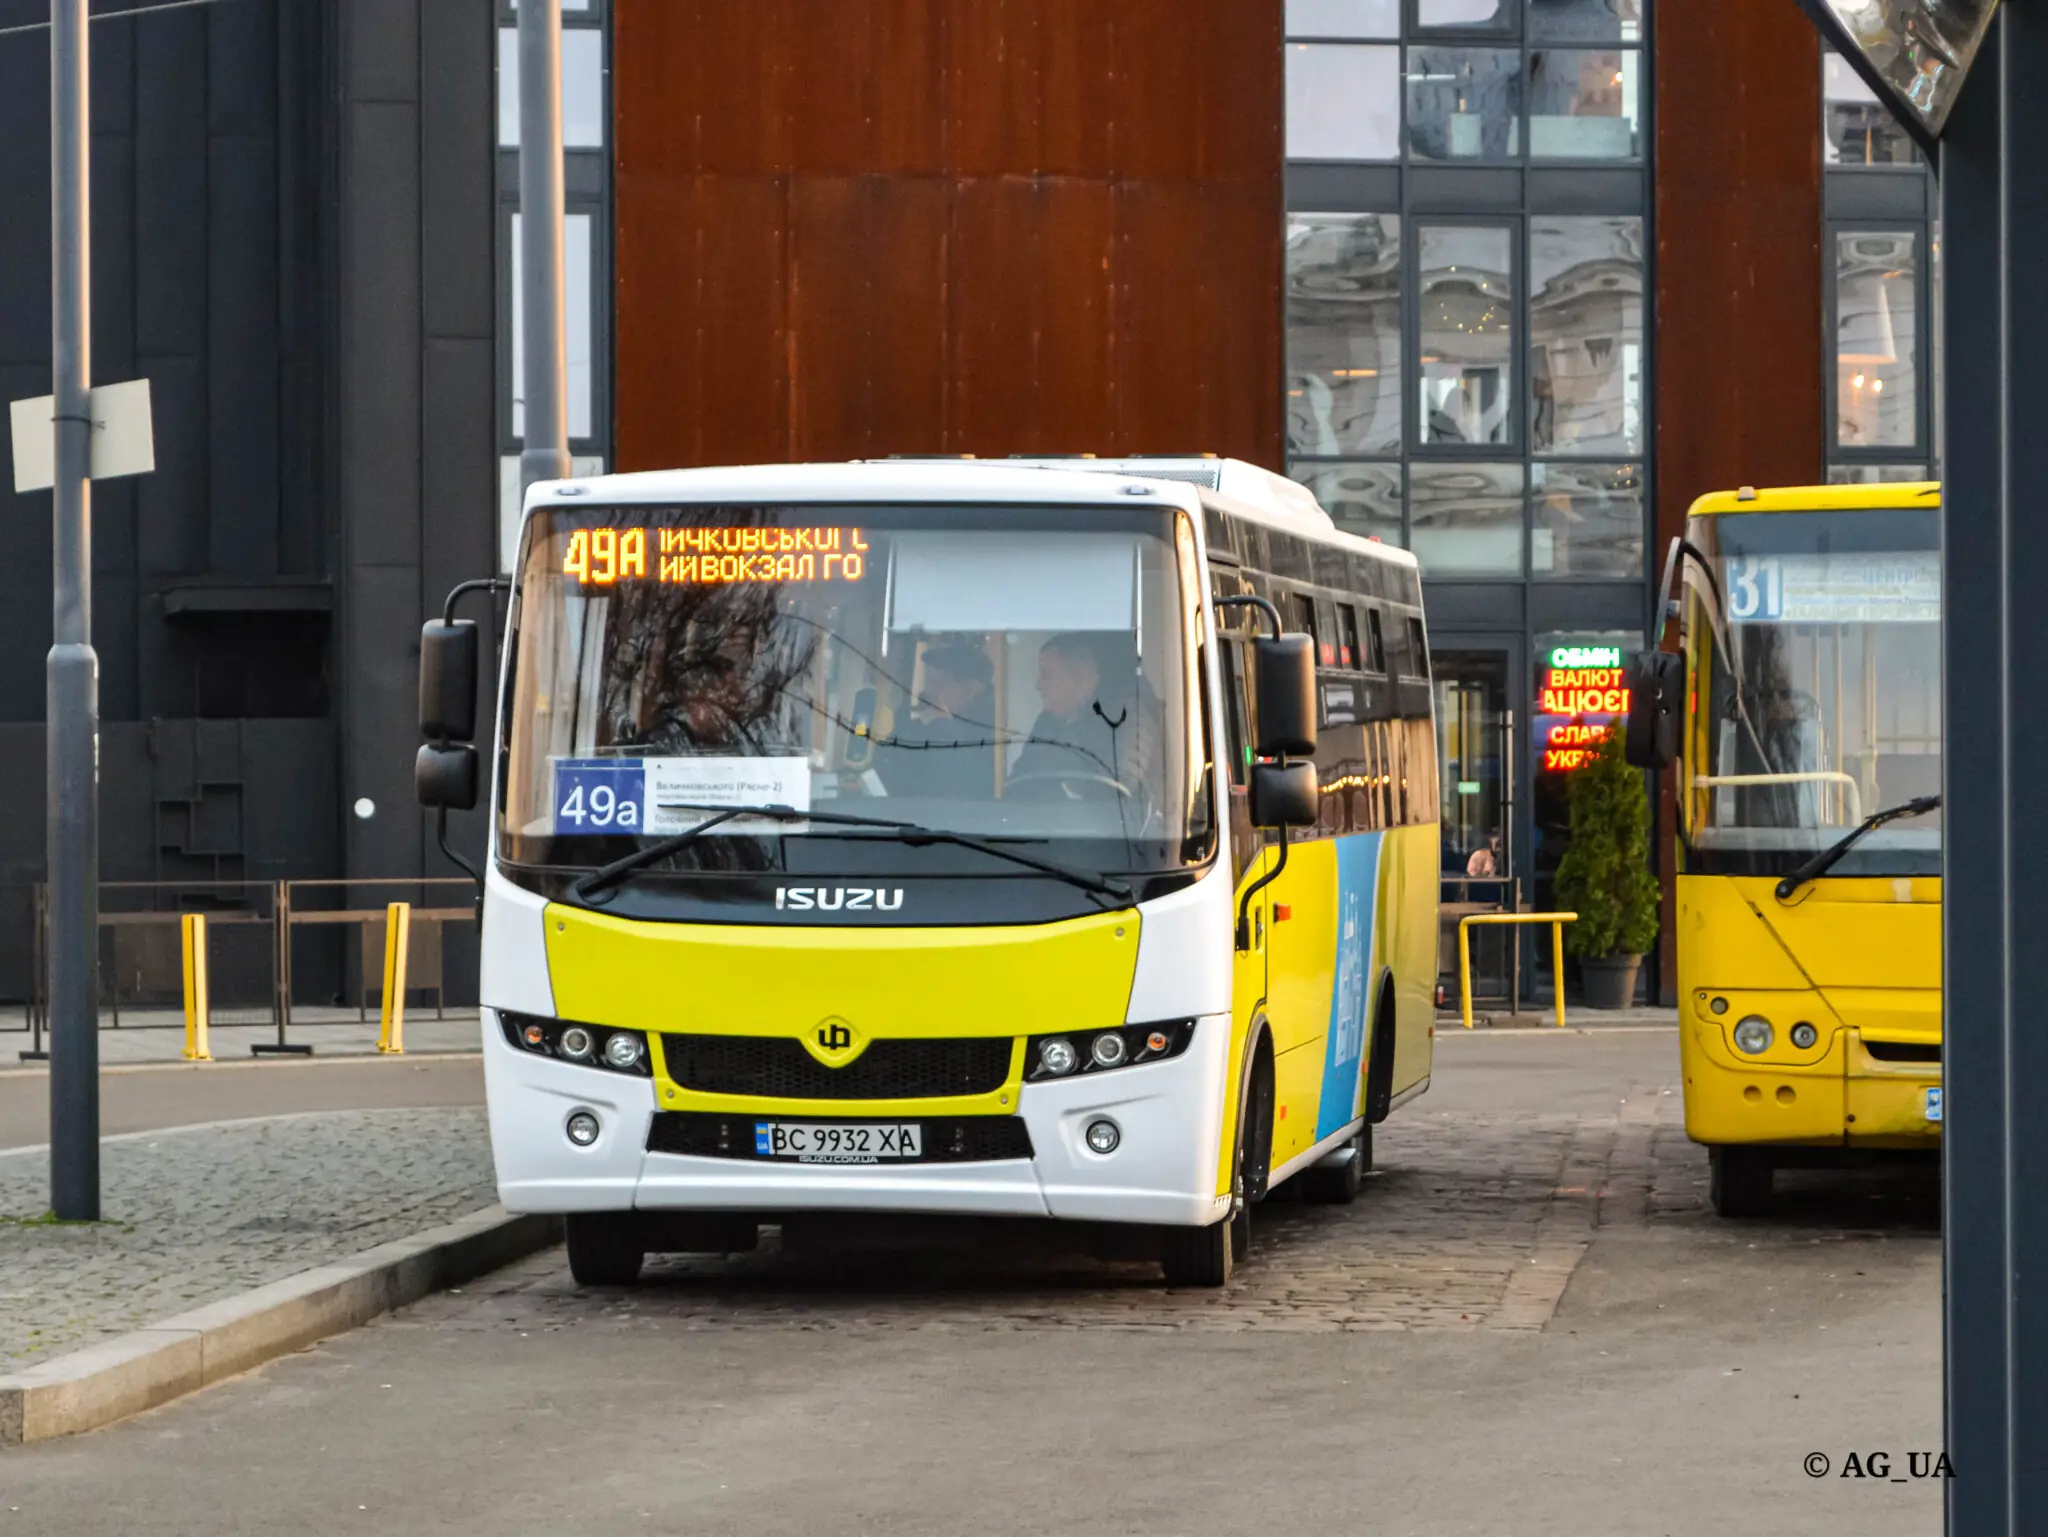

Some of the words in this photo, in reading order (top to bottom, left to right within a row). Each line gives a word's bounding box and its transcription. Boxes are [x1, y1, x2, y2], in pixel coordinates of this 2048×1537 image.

[1729, 557, 1782, 616] 31
[1551, 647, 1620, 668] ОБМІН
[1551, 669, 1623, 687] ВАЛЮТ
[560, 784, 638, 827] 49а
[775, 887, 904, 910] ISUZU
[813, 1129, 870, 1152] 9932
